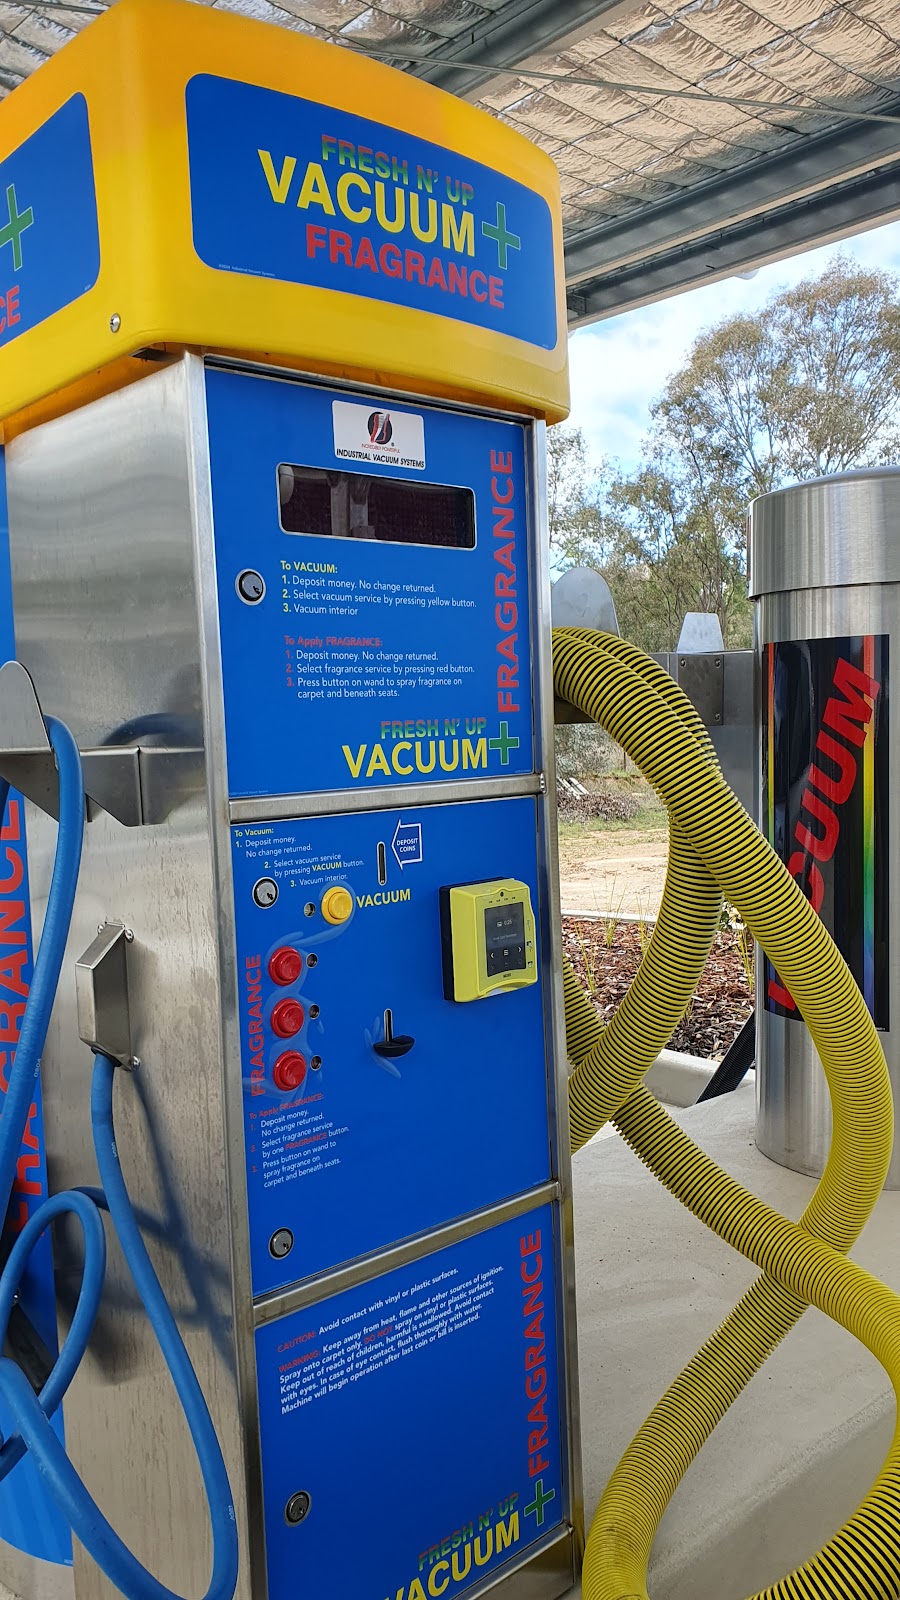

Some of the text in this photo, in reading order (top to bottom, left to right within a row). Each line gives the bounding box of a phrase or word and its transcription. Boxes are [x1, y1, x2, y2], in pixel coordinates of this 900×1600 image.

[321, 134, 409, 185] FRESH
[445, 176, 475, 206] UP
[257, 149, 475, 257] VACUUM
[305, 224, 505, 309] FRAGRANCE
[336, 449, 425, 469] INDUSTRIAL VACUUM SYSTEMS
[280, 560, 337, 573] To VACUUM:
[282, 575, 436, 593] 1. Deposit money. No change returned.
[490, 450, 520, 712] FRAGRANCE
[282, 589, 291, 598] 2.
[293, 589, 319, 600] Select
[354, 594, 381, 603] service
[383, 594, 393, 605] by
[395, 596, 426, 607] pressing
[427, 597, 450, 607] yellow
[452, 597, 476, 607] button.
[283, 603, 358, 615] 3. Vacuum interior
[284, 635, 382, 648] To Apply FRAGRANCE:
[296, 650, 438, 662] Deposit money. No change returned.
[285, 663, 474, 675] 2. Select fragrance service by pressing red button.
[287, 677, 294, 687] 3.
[298, 677, 320, 687] Press
[322, 677, 349, 686] button
[363, 677, 385, 686] wand
[386, 678, 395, 686] to
[396, 679, 416, 688] spray
[418, 677, 452, 688] fragrance
[298, 689, 399, 701] carpet and beneath seats.
[380, 719, 439, 740] FRESH
[465, 717, 487, 735] UP
[342, 737, 488, 779] VACUUM
[245, 828, 274, 836] Vacuum:
[396, 837, 418, 846] DEPOSIT
[245, 838, 271, 848] Deposit
[258, 844, 312, 857] change returned.
[399, 845, 416, 853] COINS
[274, 859, 293, 868] Select
[320, 854, 341, 862] service
[284, 860, 365, 877] pressing VACUUM button.
[299, 874, 348, 885] Vacuum interior.
[356, 888, 411, 908] VACUUM
[246, 954, 266, 1097] FRAGRANCE
[261, 1110, 309, 1128] Deposit money.
[273, 1113, 324, 1134] change returned.
[262, 1122, 333, 1149] Select fragrance service
[285, 1127, 350, 1150] FRAGRANCE button.
[263, 1143, 328, 1169] Press button wand
[264, 1159, 311, 1180] spray fragrance
[264, 1159, 342, 1188] carpet beneath seats.
[278, 1268, 458, 1353] CAUTION: Avoid contact with vinyl plastic surfaces.
[279, 1266, 503, 1373] WARNING: Keep away from heat, flame other sources ignition.
[280, 1280, 493, 1384] Spray onto carpet only. spray vinyl plastic surfaces.
[280, 1288, 494, 1394] Keep reach children, harmful swallowed. Avoid contact
[281, 1304, 482, 1404] with eyes. case contact, flush thoroughly with water.
[282, 1314, 480, 1414] Machine will begin operation after last coin bill inserted.
[520, 1229, 549, 1478] FRAGRANCE
[418, 1520, 474, 1572] FRESH
[498, 1492, 519, 1517] UP
